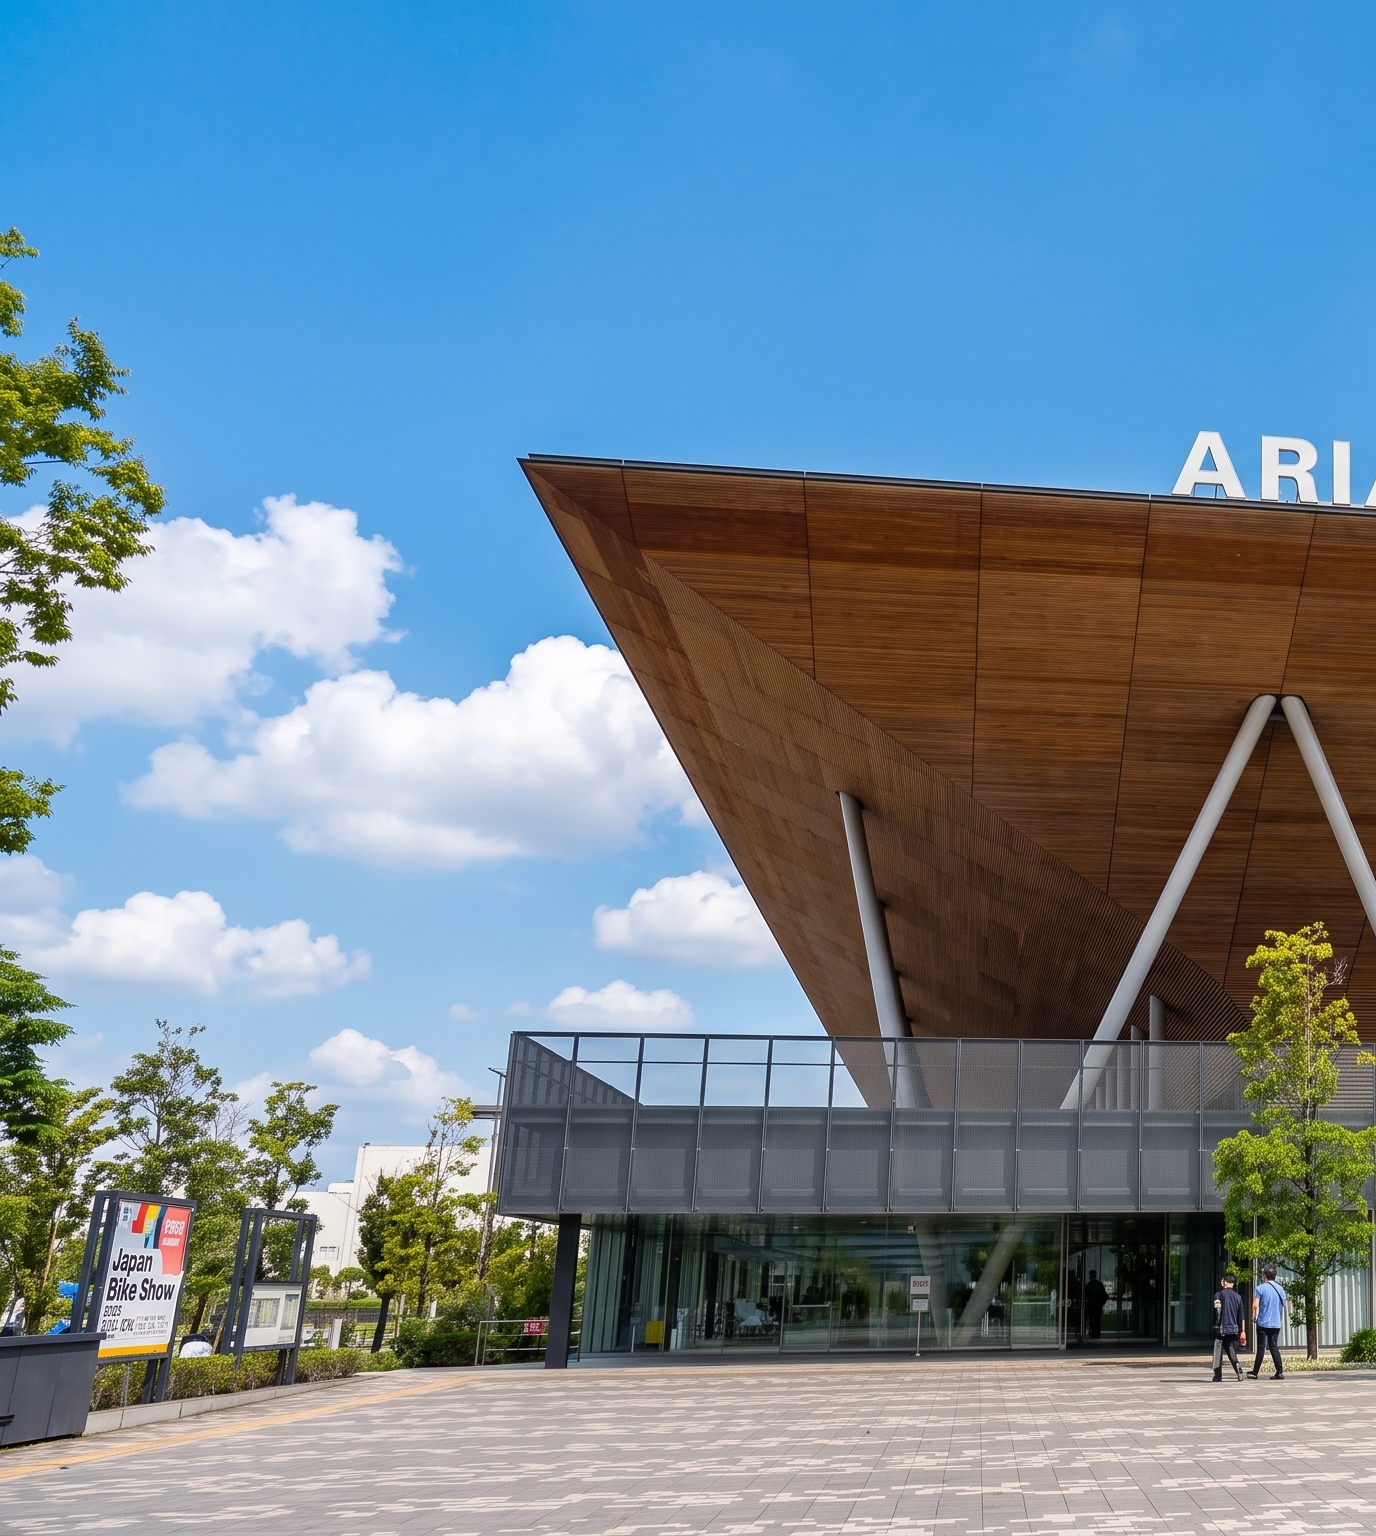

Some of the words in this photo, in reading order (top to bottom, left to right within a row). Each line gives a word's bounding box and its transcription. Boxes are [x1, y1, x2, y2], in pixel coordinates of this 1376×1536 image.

[112, 1248, 153, 1277] Japan
[106, 1277, 137, 1301] Bike
[139, 1278, 175, 1301] Show
